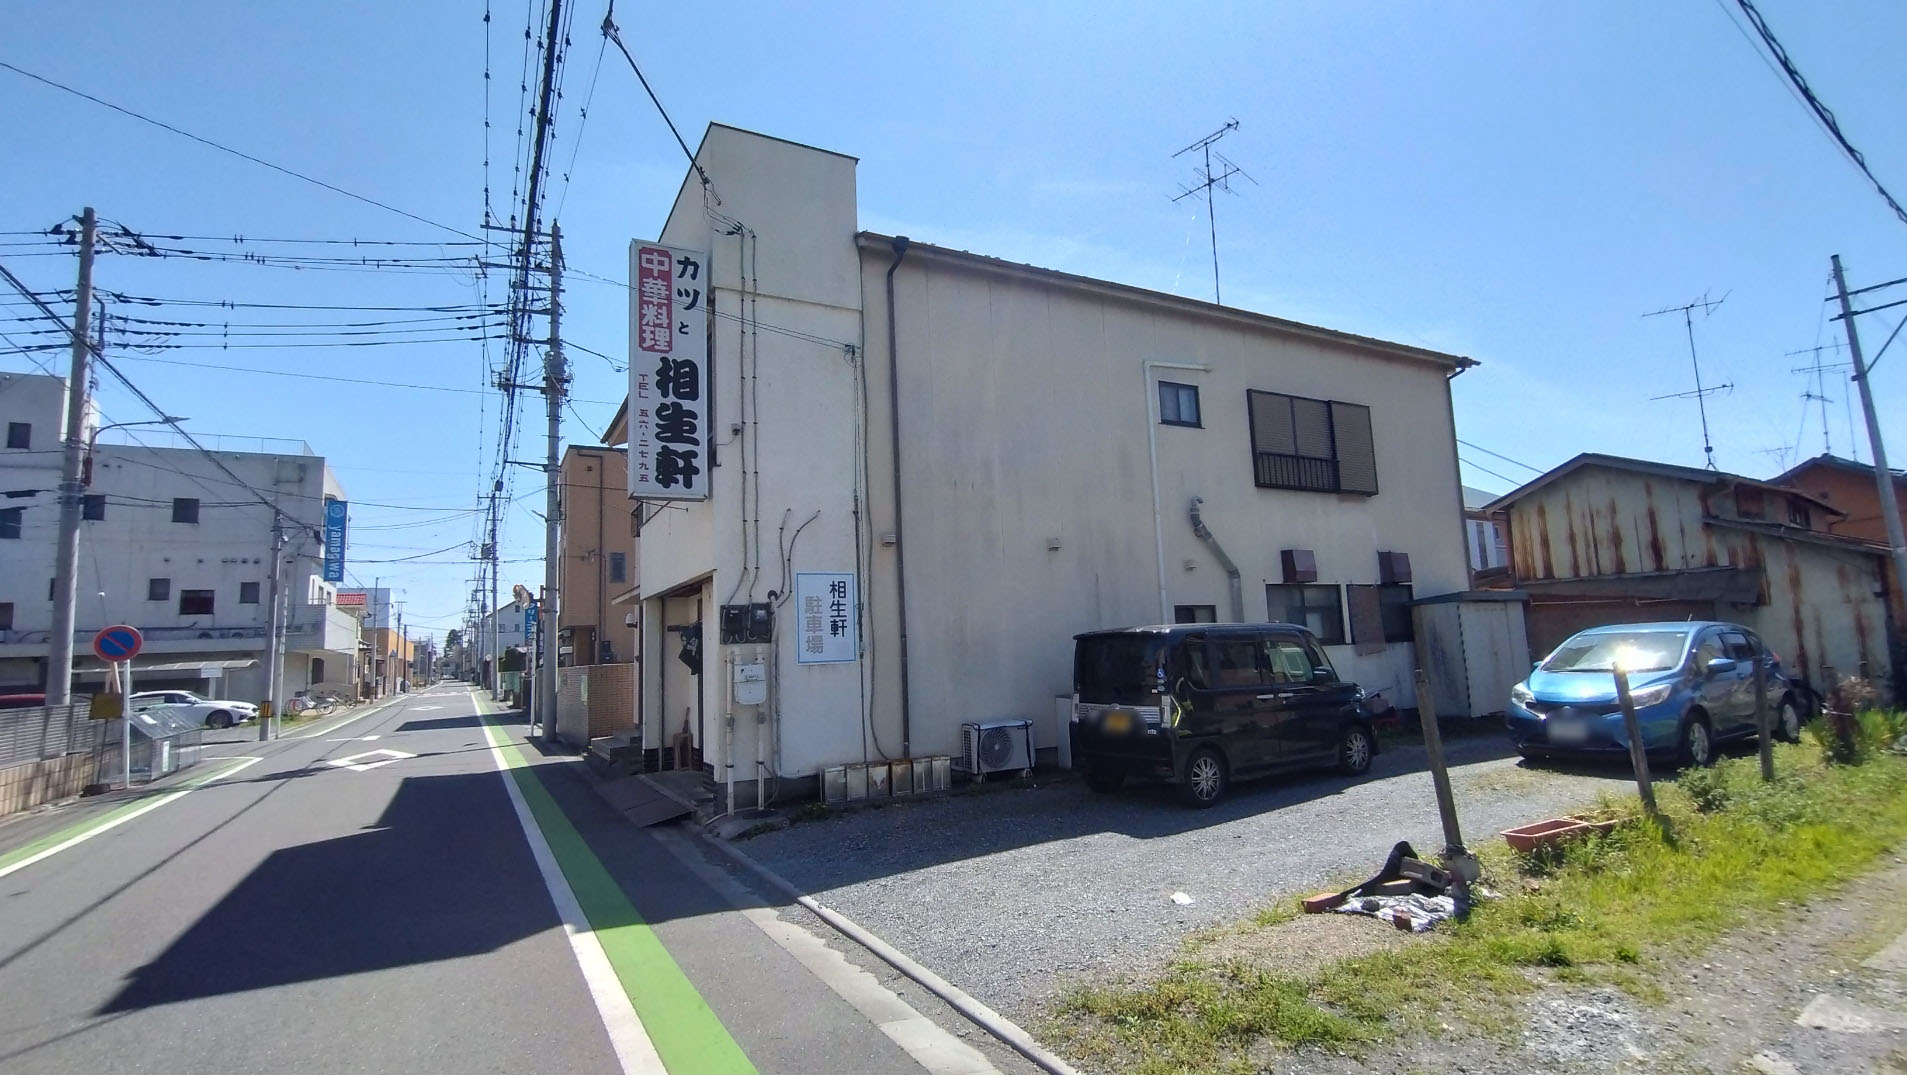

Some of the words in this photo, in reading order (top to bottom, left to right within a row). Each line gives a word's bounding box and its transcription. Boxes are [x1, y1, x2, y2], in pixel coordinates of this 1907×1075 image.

[640, 252, 671, 351] 中華料理
[677, 256, 700, 335] カツと
[638, 373, 649, 398] TEL
[655, 356, 700, 489] 相生軒
[327, 525, 341, 578] yamagiwa
[804, 595, 824, 654] 駐車場
[829, 580, 847, 637] 相生軒
